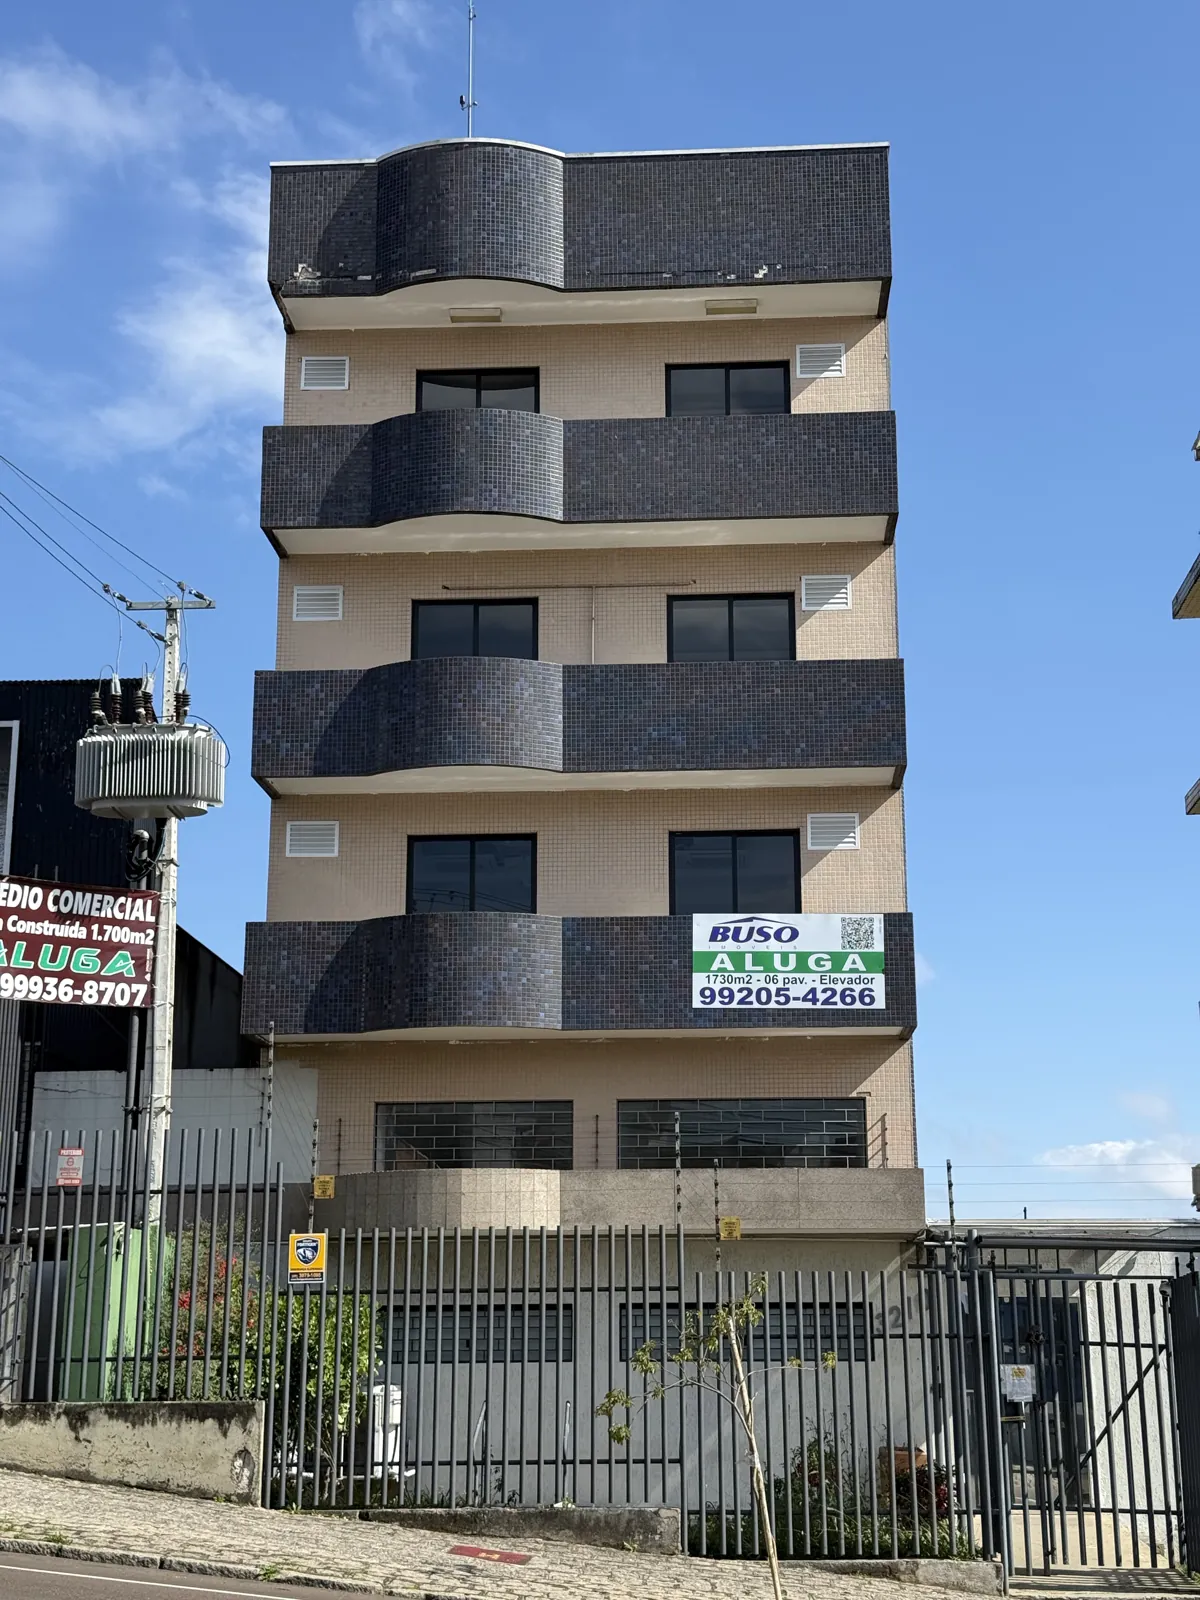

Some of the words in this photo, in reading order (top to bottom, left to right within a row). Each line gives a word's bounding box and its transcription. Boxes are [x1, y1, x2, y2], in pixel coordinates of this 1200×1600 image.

[47, 888, 156, 922] COMERCIAL
[7, 915, 87, 940] Construída
[91, 923, 155, 945] 1.700m2
[708, 926, 799, 943] BUSO
[710, 953, 867, 972] ALUGA
[0, 973, 148, 1007] 99936-8707
[705, 975, 753, 984] 1730m2
[764, 975, 779, 984] 06
[783, 976, 808, 986] pav.
[820, 975, 875, 984] Elevador
[699, 987, 876, 1006] 99205-4266
